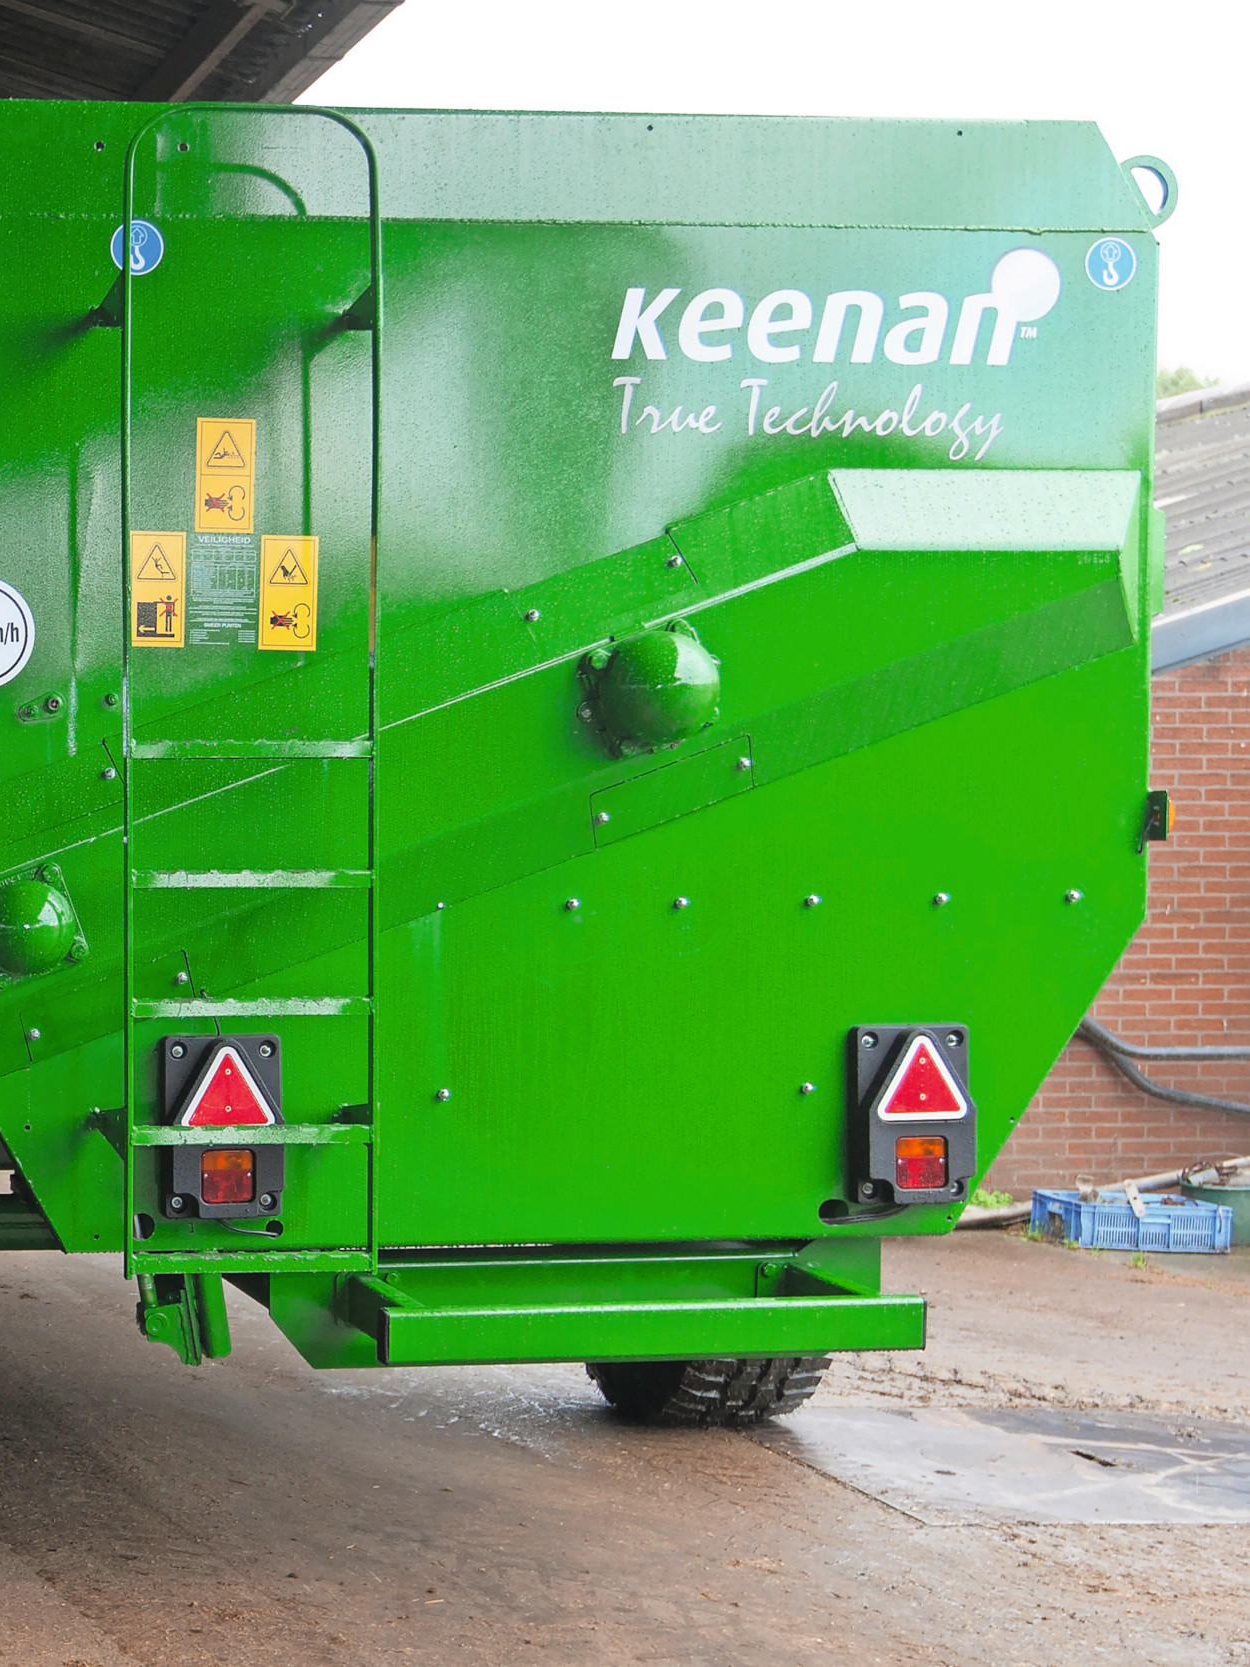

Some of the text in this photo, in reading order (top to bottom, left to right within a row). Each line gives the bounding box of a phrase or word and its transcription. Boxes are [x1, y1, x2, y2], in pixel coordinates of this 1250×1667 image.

[613, 376, 1005, 462] True Technology
[198, 535, 252, 544] VEILIGHEID
